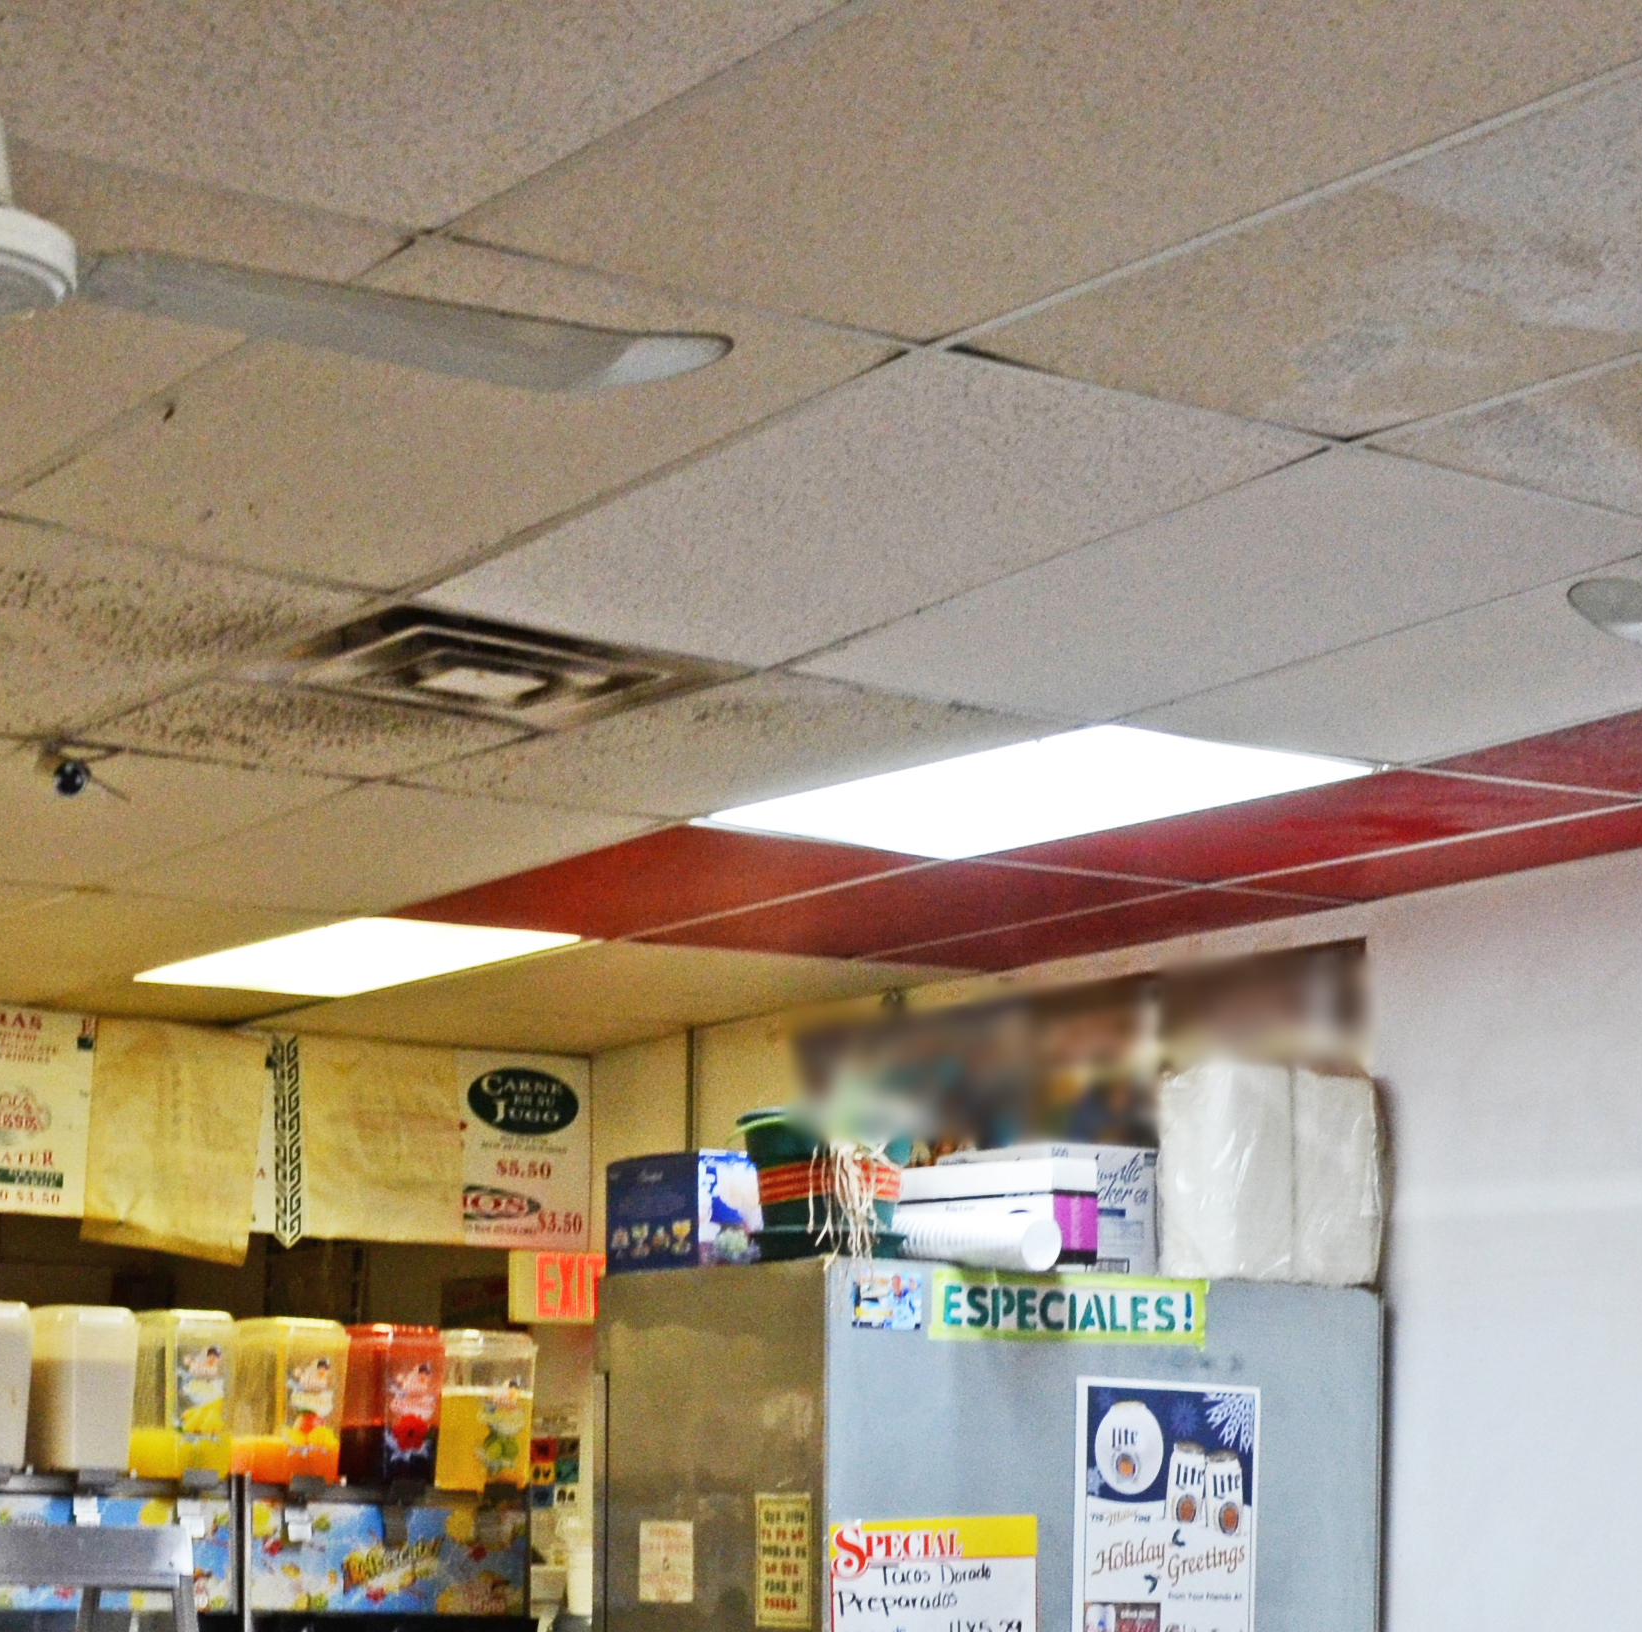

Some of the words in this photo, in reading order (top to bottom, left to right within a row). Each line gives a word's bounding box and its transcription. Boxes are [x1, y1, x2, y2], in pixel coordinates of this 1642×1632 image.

[535, 1251, 606, 1319] EXIT
[943, 1284, 1194, 1334] ESPECIALES!
[831, 1525, 964, 1579] SPECIAL
[1092, 1537, 1166, 1576] Holiday
[1167, 1545, 1245, 1588] Greetings
[882, 1564, 932, 1587] Tacos
[837, 1590, 958, 1617] Preparados
